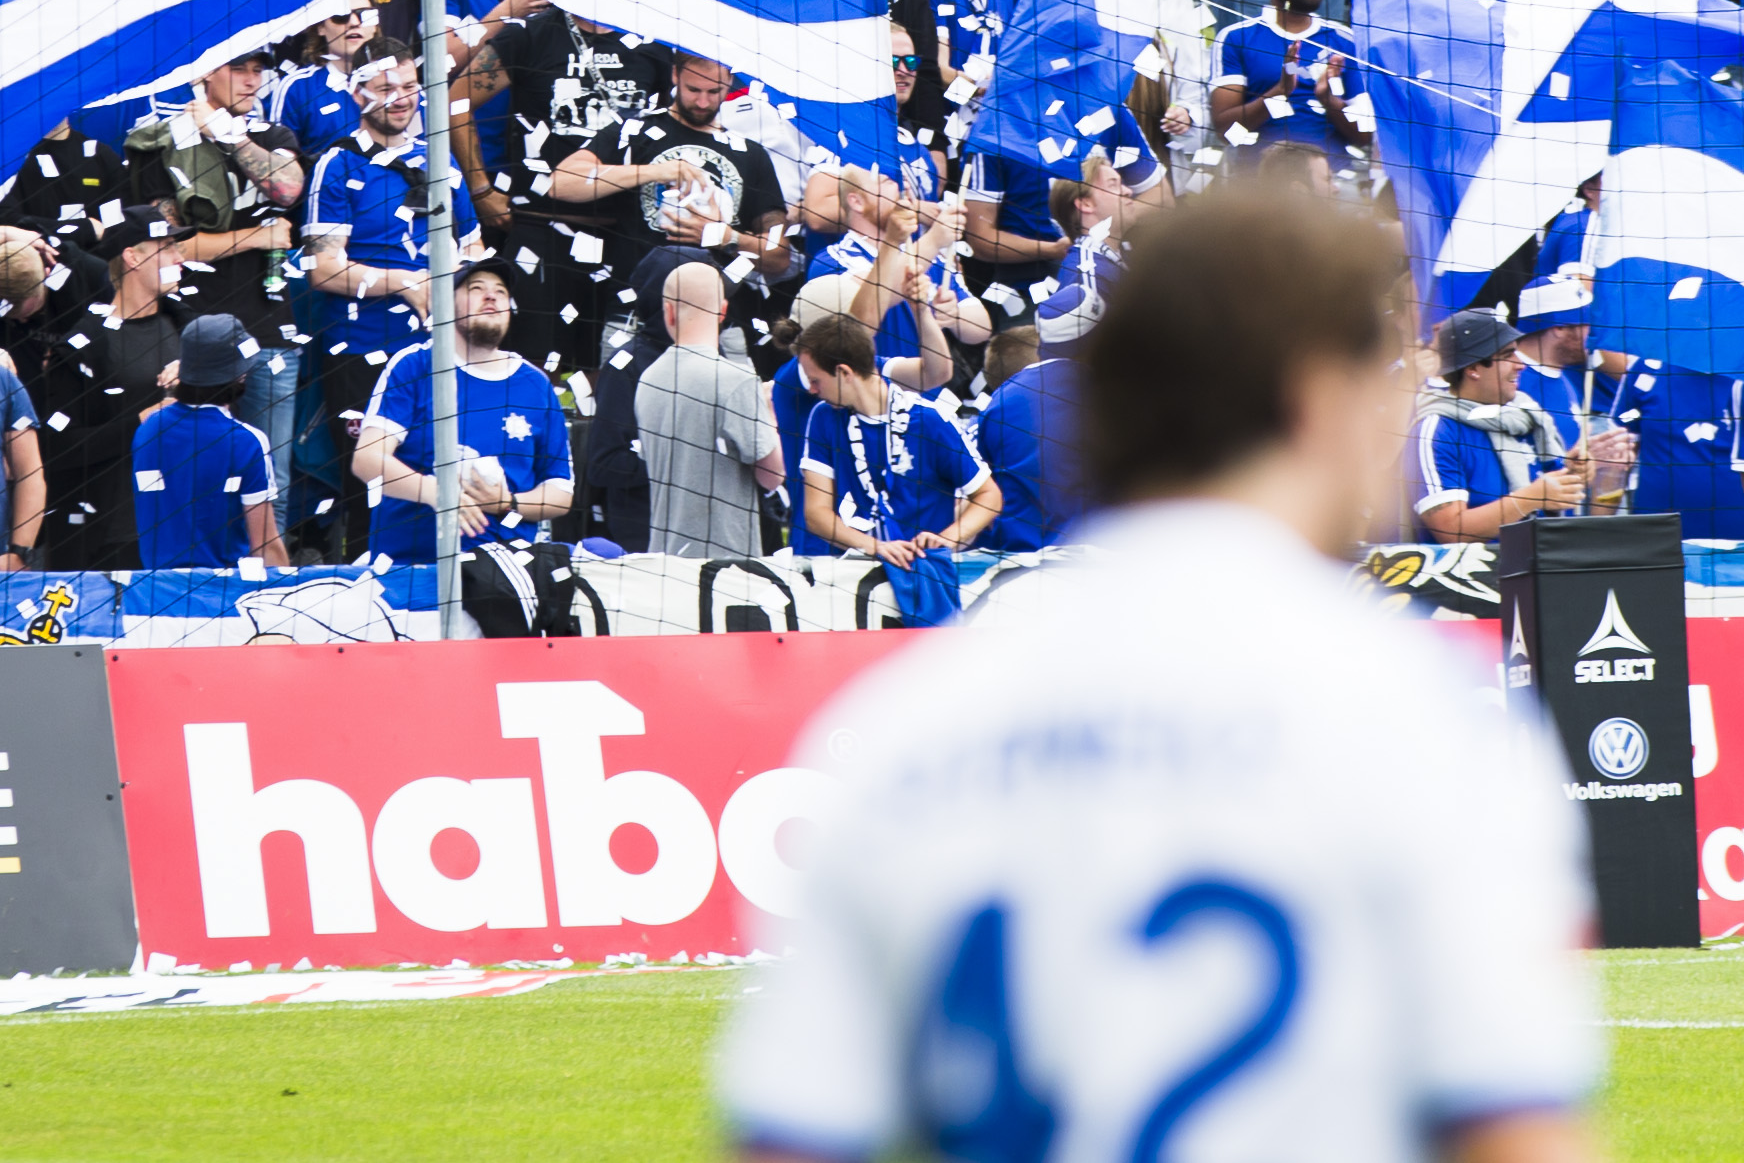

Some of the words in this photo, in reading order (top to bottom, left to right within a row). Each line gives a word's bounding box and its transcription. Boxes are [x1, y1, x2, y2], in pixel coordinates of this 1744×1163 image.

[567, 53, 624, 77] HRDA
[1575, 658, 1656, 683] SELECT
[1562, 781, 1682, 802] Volkswagen
